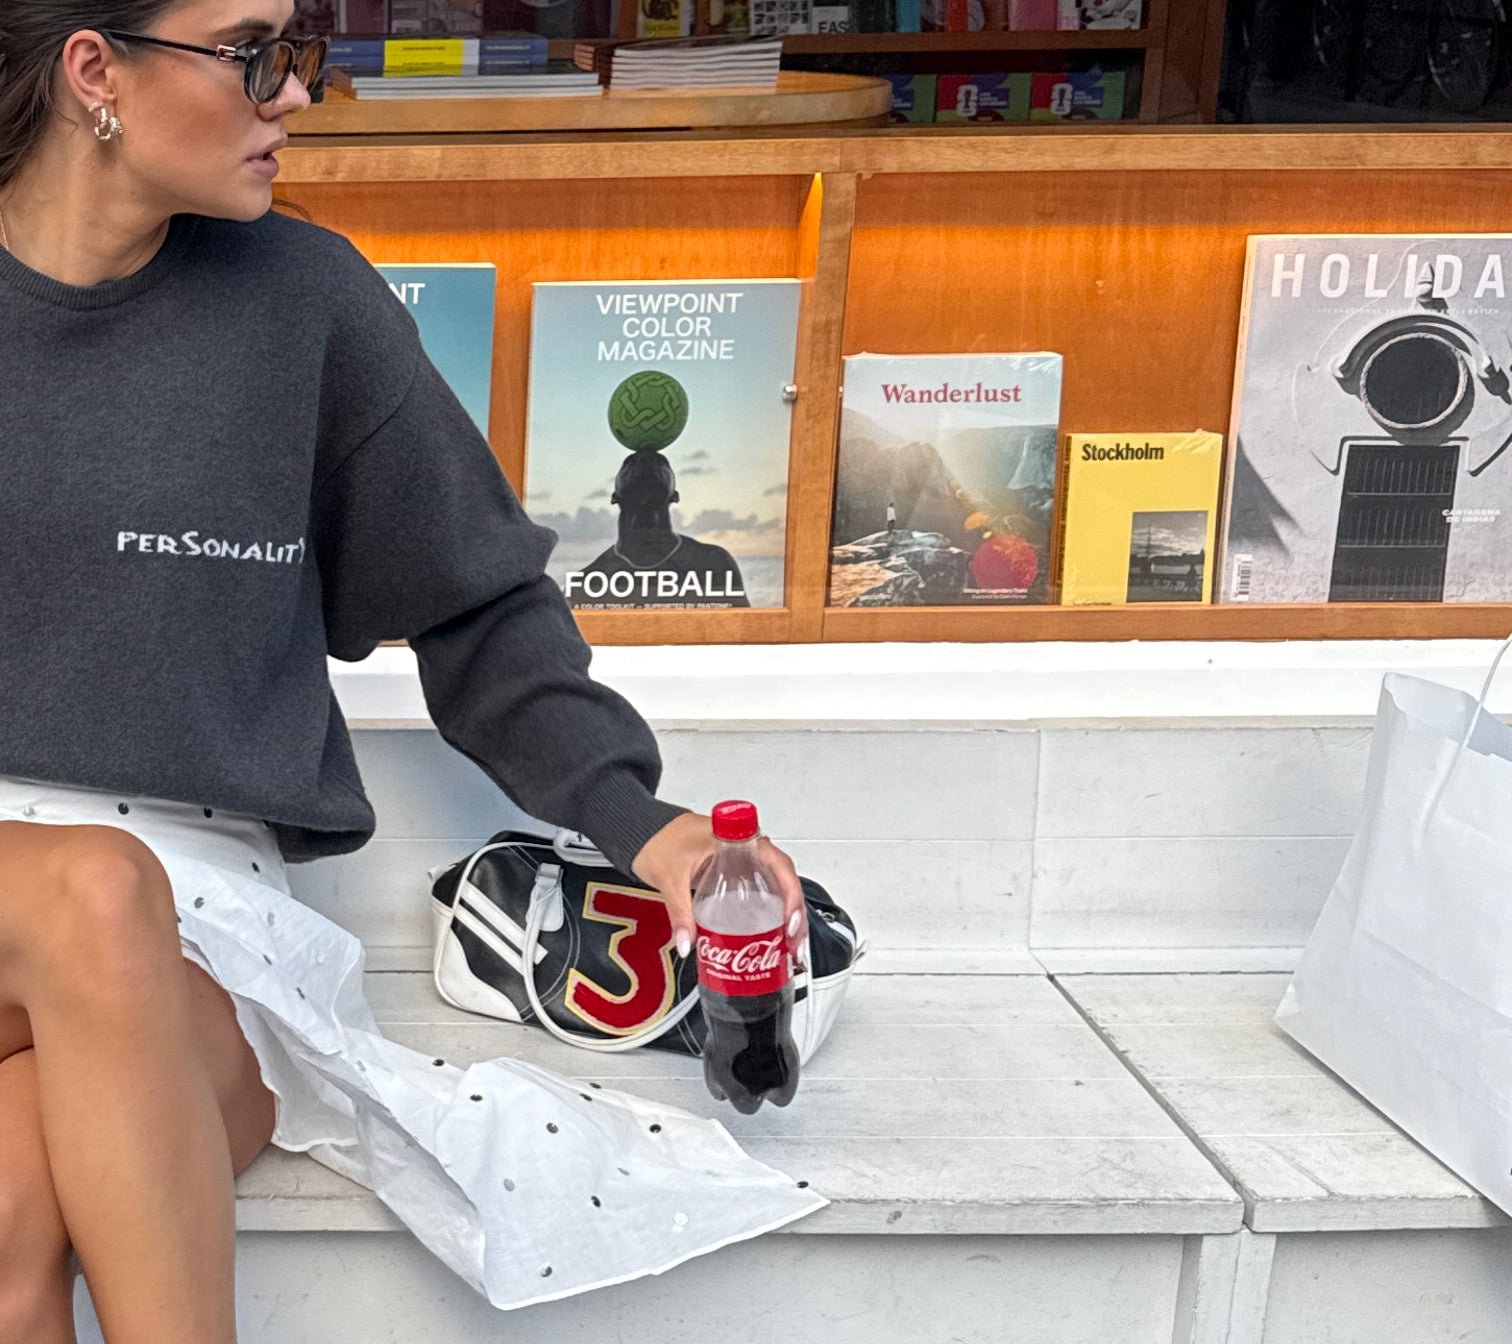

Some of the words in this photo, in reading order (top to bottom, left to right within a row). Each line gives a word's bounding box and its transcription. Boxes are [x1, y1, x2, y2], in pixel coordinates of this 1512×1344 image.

[1271, 253, 1506, 299] HOLIDA
[595, 292, 744, 315] VIEWPOINT
[622, 316, 712, 338] COLOR
[597, 339, 735, 361] MAGAZINE
[881, 381, 1023, 404] Wanderlust
[1081, 442, 1165, 461] Stockholm
[565, 570, 745, 597] FOOTBALL
[564, 881, 676, 1036] 3
[697, 934, 784, 974] Coca-Cola
[706, 968, 743, 981] ORIGINAL
[744, 970, 772, 981] TASTE
